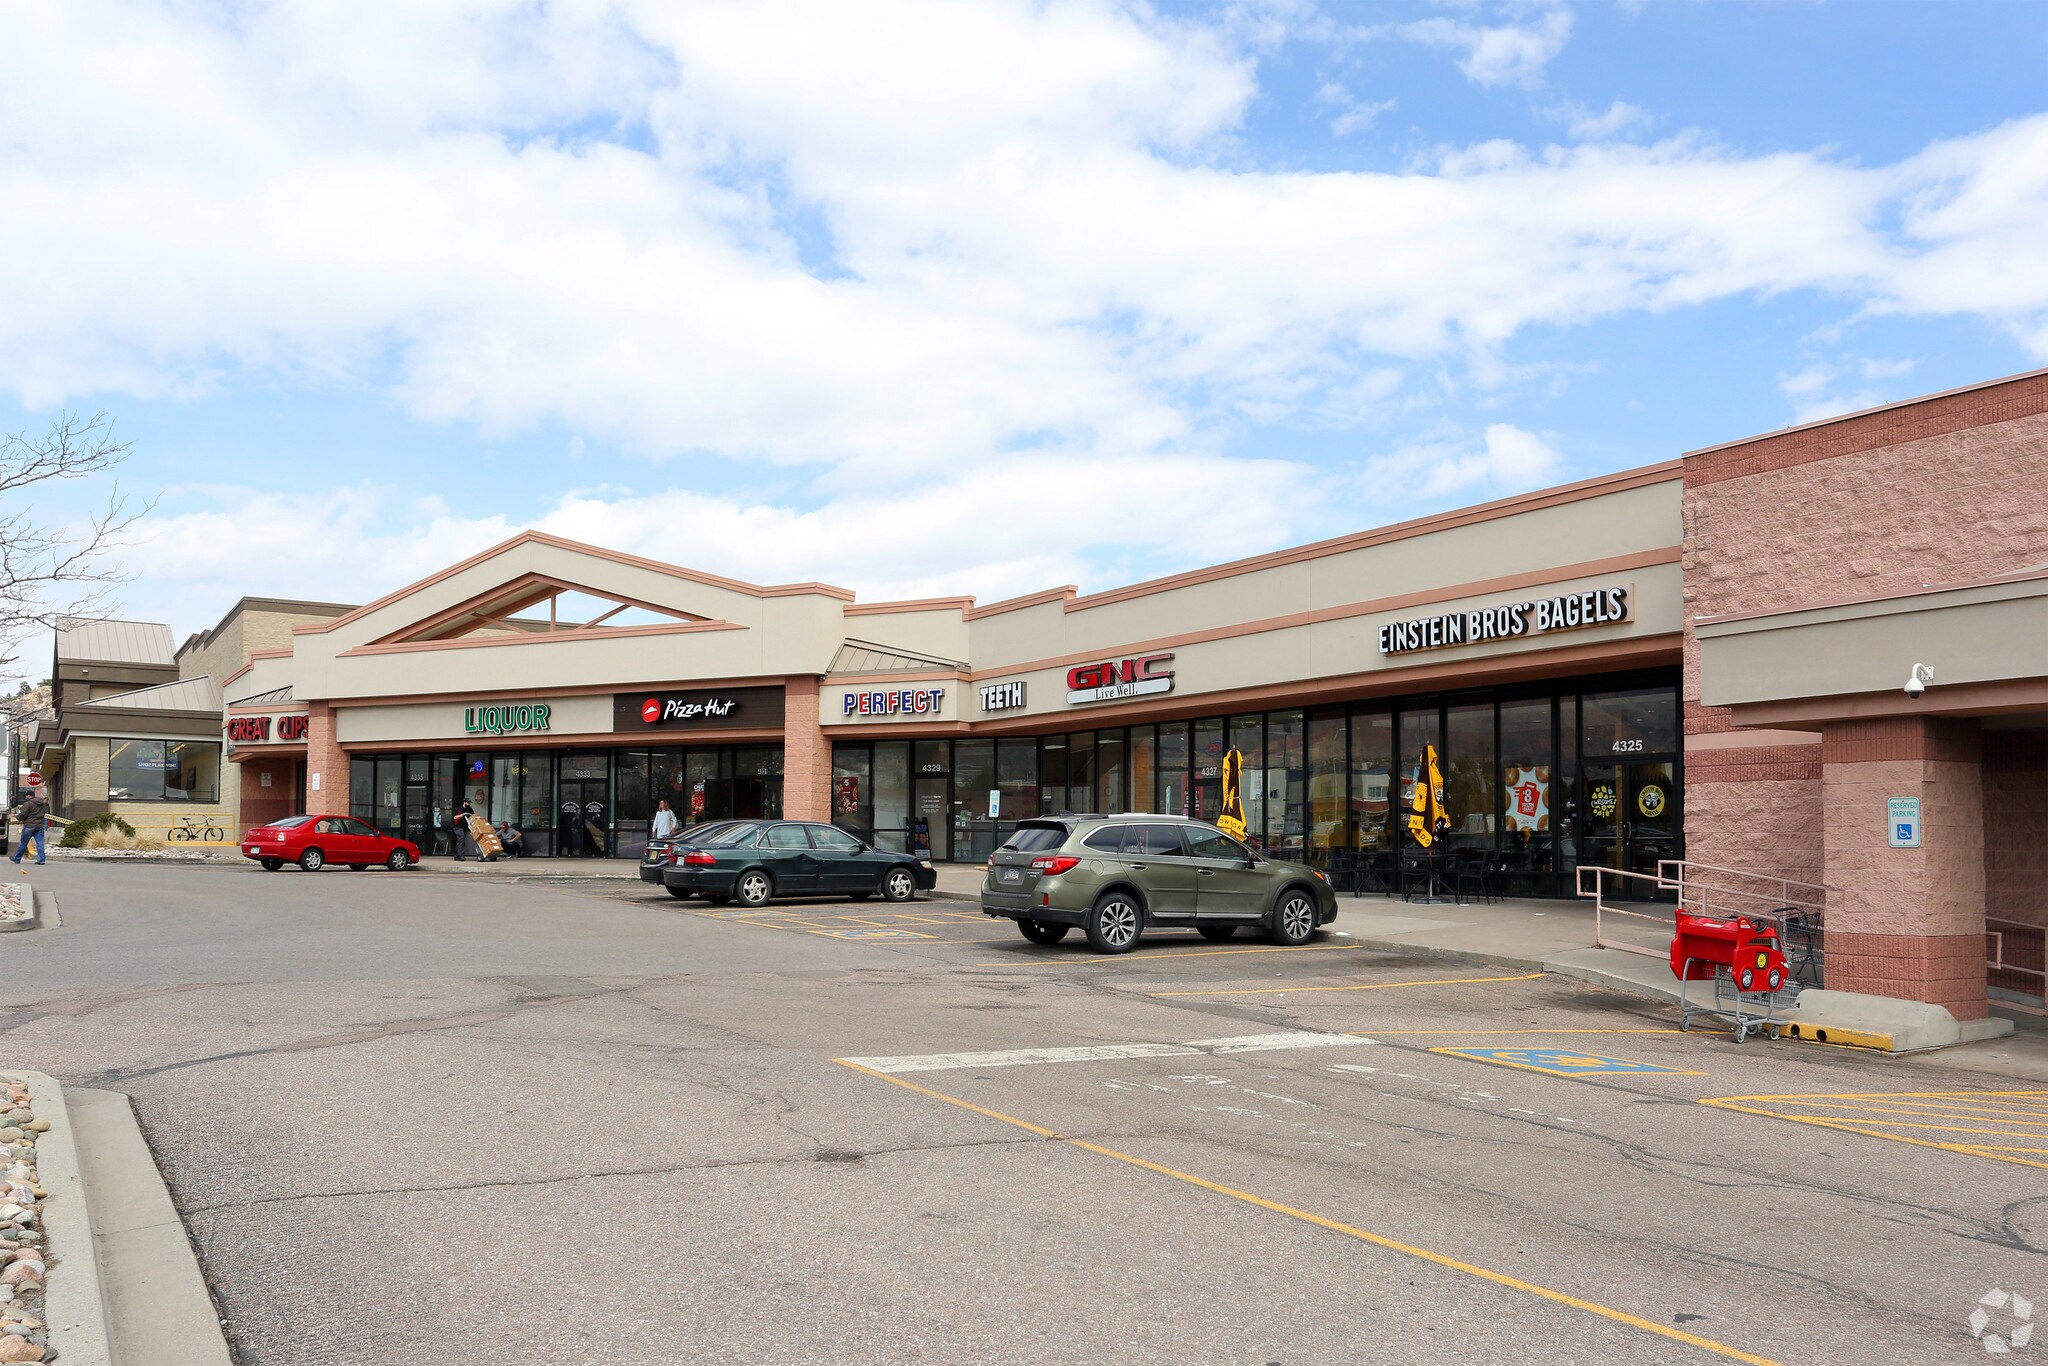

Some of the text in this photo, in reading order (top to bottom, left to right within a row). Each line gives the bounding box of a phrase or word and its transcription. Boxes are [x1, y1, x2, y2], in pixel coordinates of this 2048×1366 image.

[1378, 613, 1466, 653] EINSTEIN
[1536, 587, 1626, 631] BAGELS
[1066, 653, 1175, 690] GNC
[842, 681, 1026, 715] PERFECT TEETH
[1095, 686, 1115, 700] Live
[663, 699, 736, 720] Pizza Hut
[464, 703, 549, 734] LIQUOR
[227, 715, 309, 741] GREAT CLIPS
[1612, 739, 1643, 752] 4325
[576, 770, 591, 778] 4333
[922, 764, 941, 772] 4329
[1201, 767, 1217, 776] 4327
[410, 773, 424, 781] 4335
